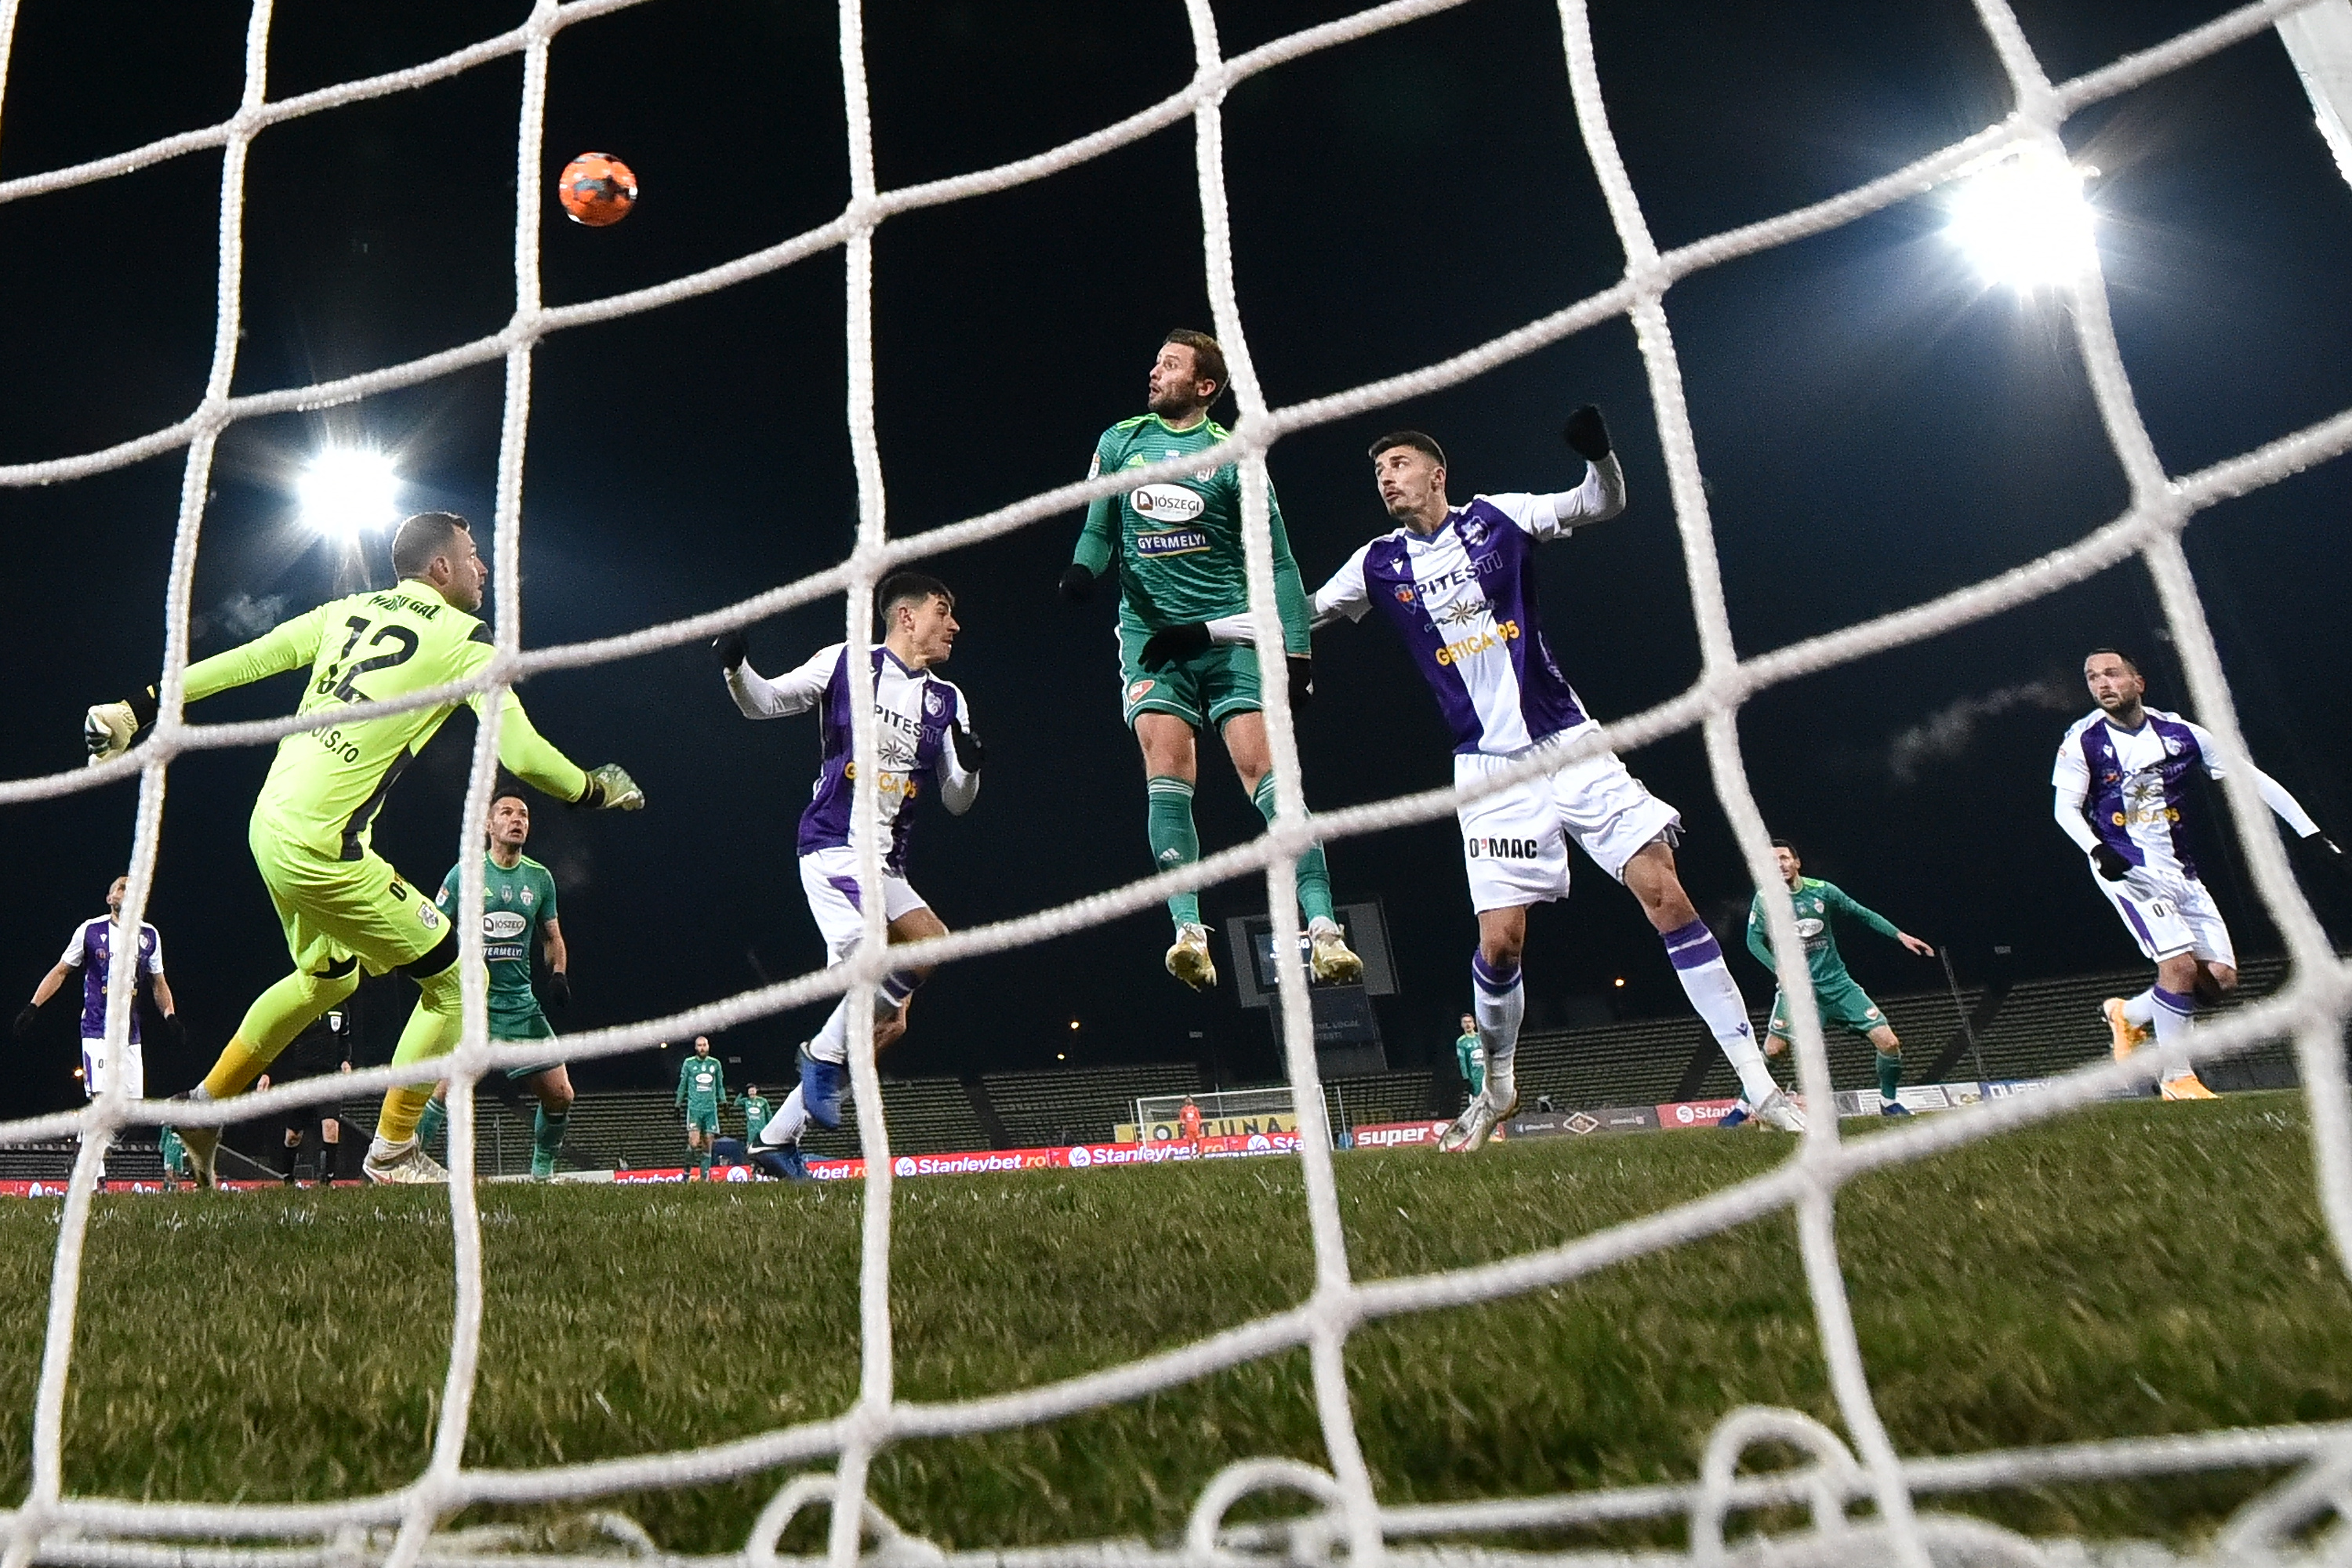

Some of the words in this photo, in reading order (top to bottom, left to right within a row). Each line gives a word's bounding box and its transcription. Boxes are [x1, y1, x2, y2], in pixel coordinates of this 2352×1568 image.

[1138, 533, 1207, 550] GYERMELYI
[1434, 632, 1496, 666] GETICA
[1496, 619, 1520, 642] 95
[317, 615, 419, 703] 12
[2163, 807, 2181, 822] 95
[483, 946, 523, 956] YERMELYI
[1357, 1126, 1430, 1147] super
